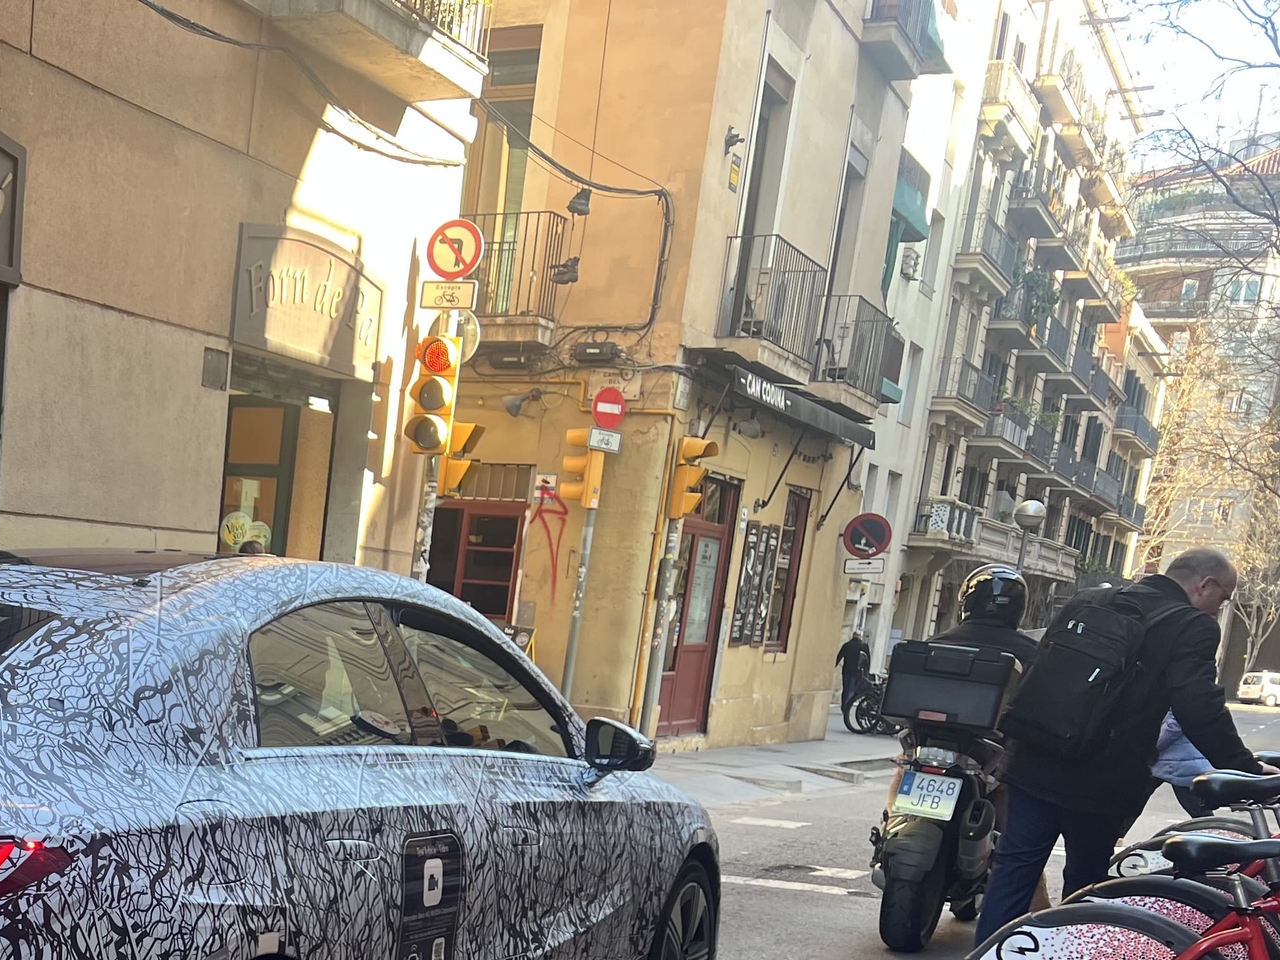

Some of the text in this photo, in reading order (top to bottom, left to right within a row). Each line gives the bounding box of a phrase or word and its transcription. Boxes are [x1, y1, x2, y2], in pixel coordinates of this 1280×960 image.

[246, 260, 310, 318] Forn
[314, 258, 344, 319] de
[746, 373, 761, 399] CAN
[916, 778, 956, 796] 4648
[911, 794, 941, 809] JFB
